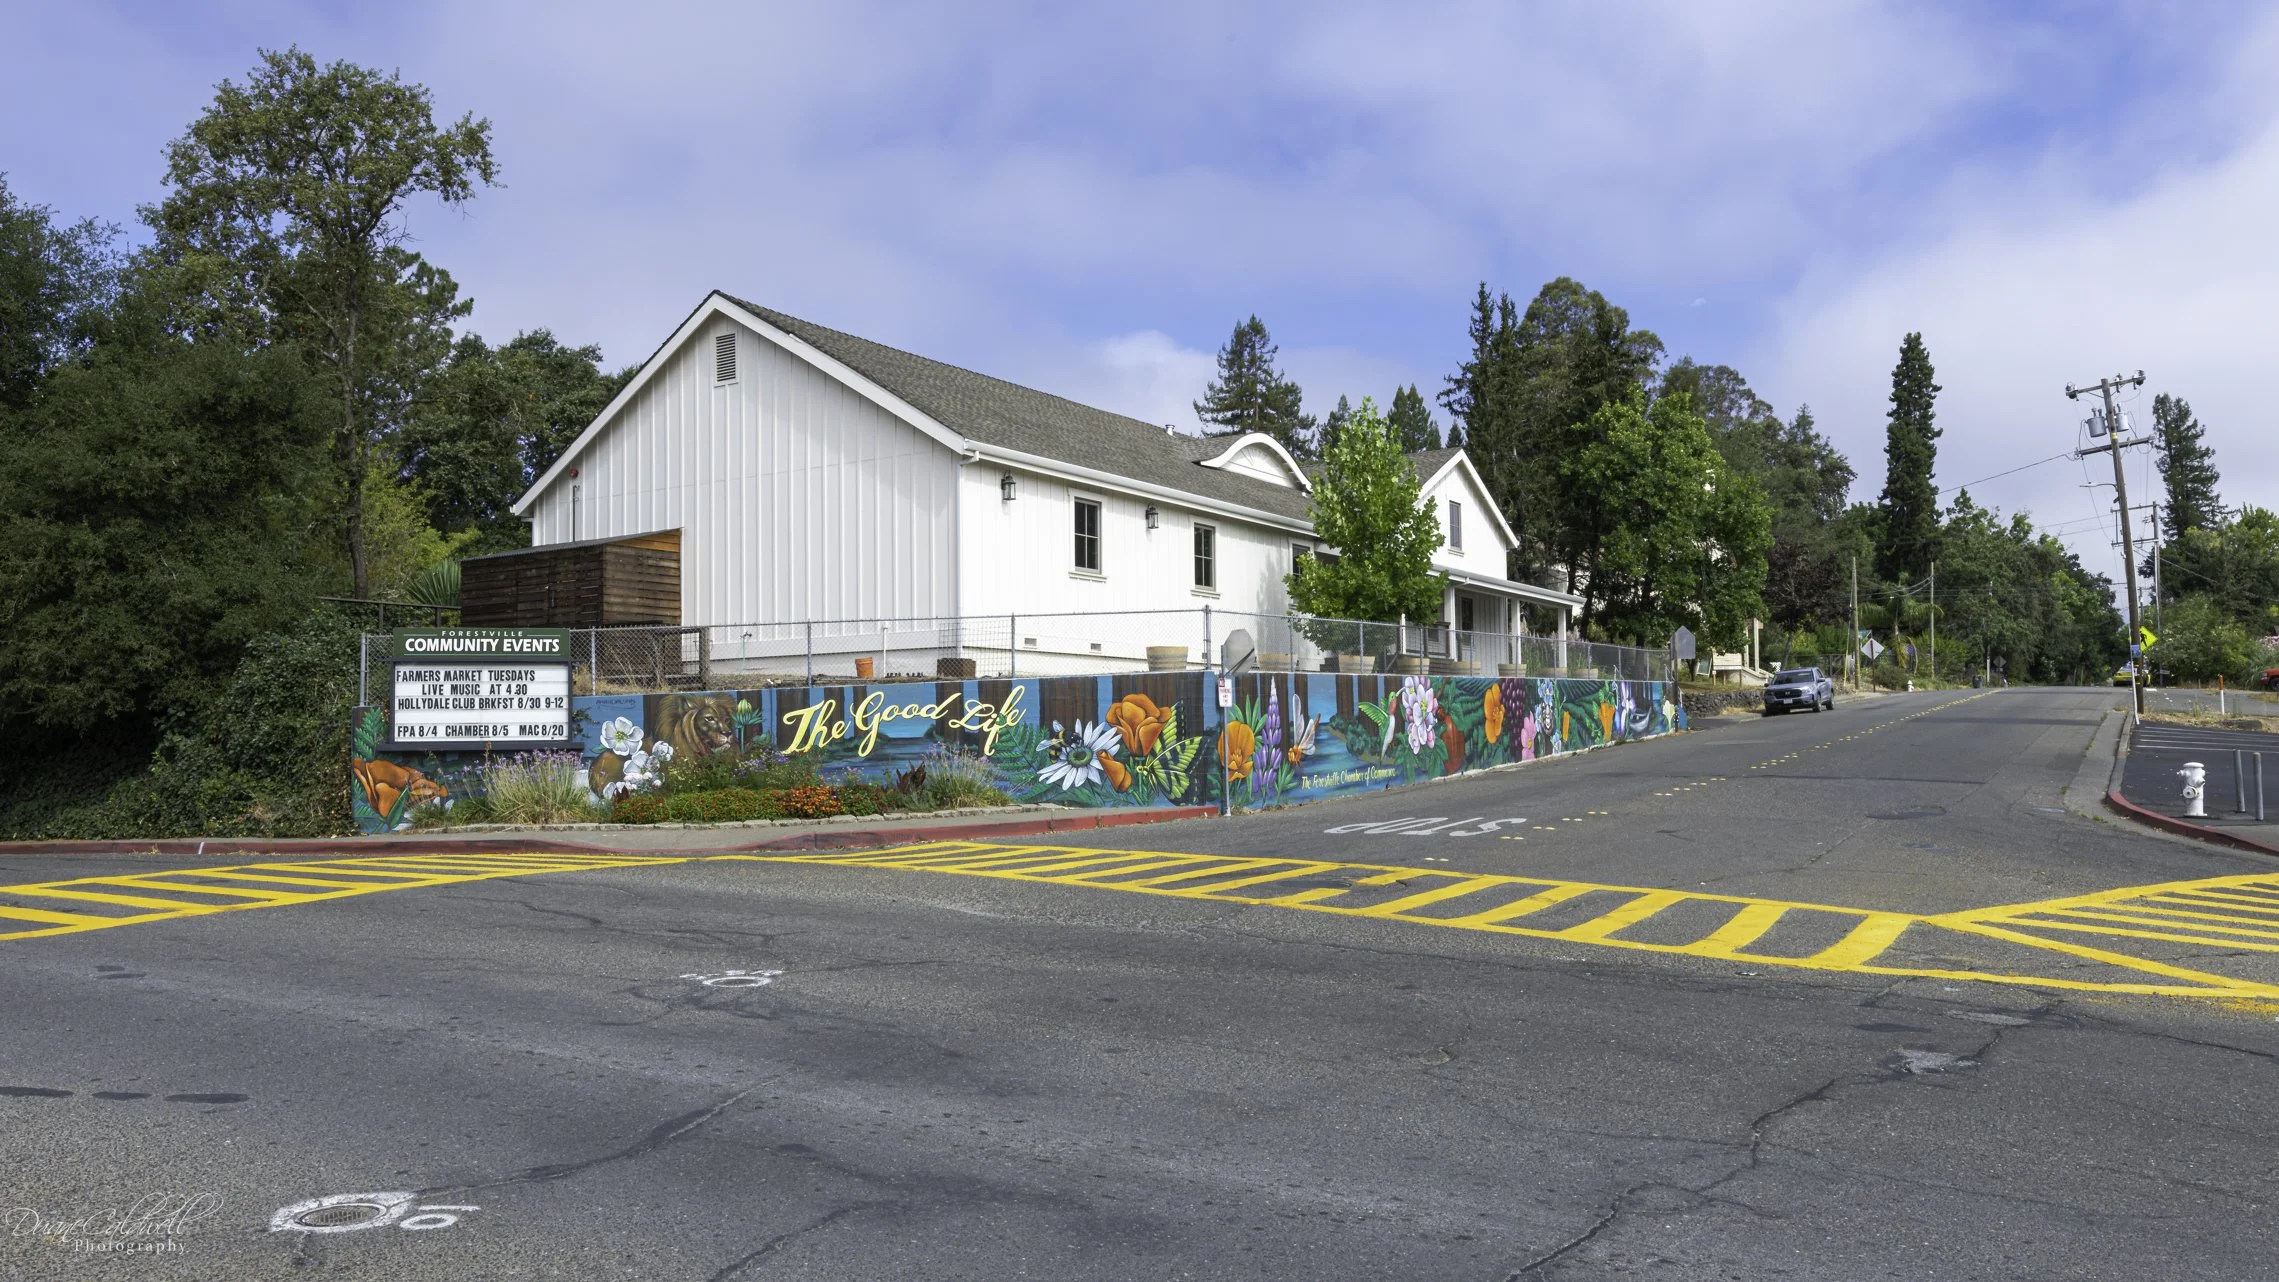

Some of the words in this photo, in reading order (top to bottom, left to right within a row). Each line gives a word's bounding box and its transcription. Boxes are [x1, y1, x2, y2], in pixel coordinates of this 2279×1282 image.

[404, 638, 499, 652] COMMUNITY
[503, 638, 560, 652] EVENTS
[396, 670, 441, 682] FARMERS
[443, 670, 482, 682] MARKET
[488, 669, 535, 681] TUESDAYS
[421, 684, 444, 695] LIVE
[450, 684, 481, 695] MUSIC
[489, 684, 502, 695] AT
[398, 698, 450, 710] HOLLYDALE
[452, 698, 475, 709] CLUB
[478, 697, 514, 709] BRKFST
[517, 697, 541, 709] 8/30
[545, 697, 564, 708] 9-12
[782, 699, 851, 756] The
[850, 691, 962, 757] Good
[948, 684, 1026, 757] Life
[397, 725, 415, 737] FPA
[418, 725, 438, 737] 8/4
[445, 725, 490, 737] CHAMBER
[492, 725, 509, 736] 8/5
[519, 725, 540, 736] MAC
[541, 725, 564, 736] 8/20
[1301, 775, 1311, 790] The
[1340, 769, 1364, 785] Chamber
